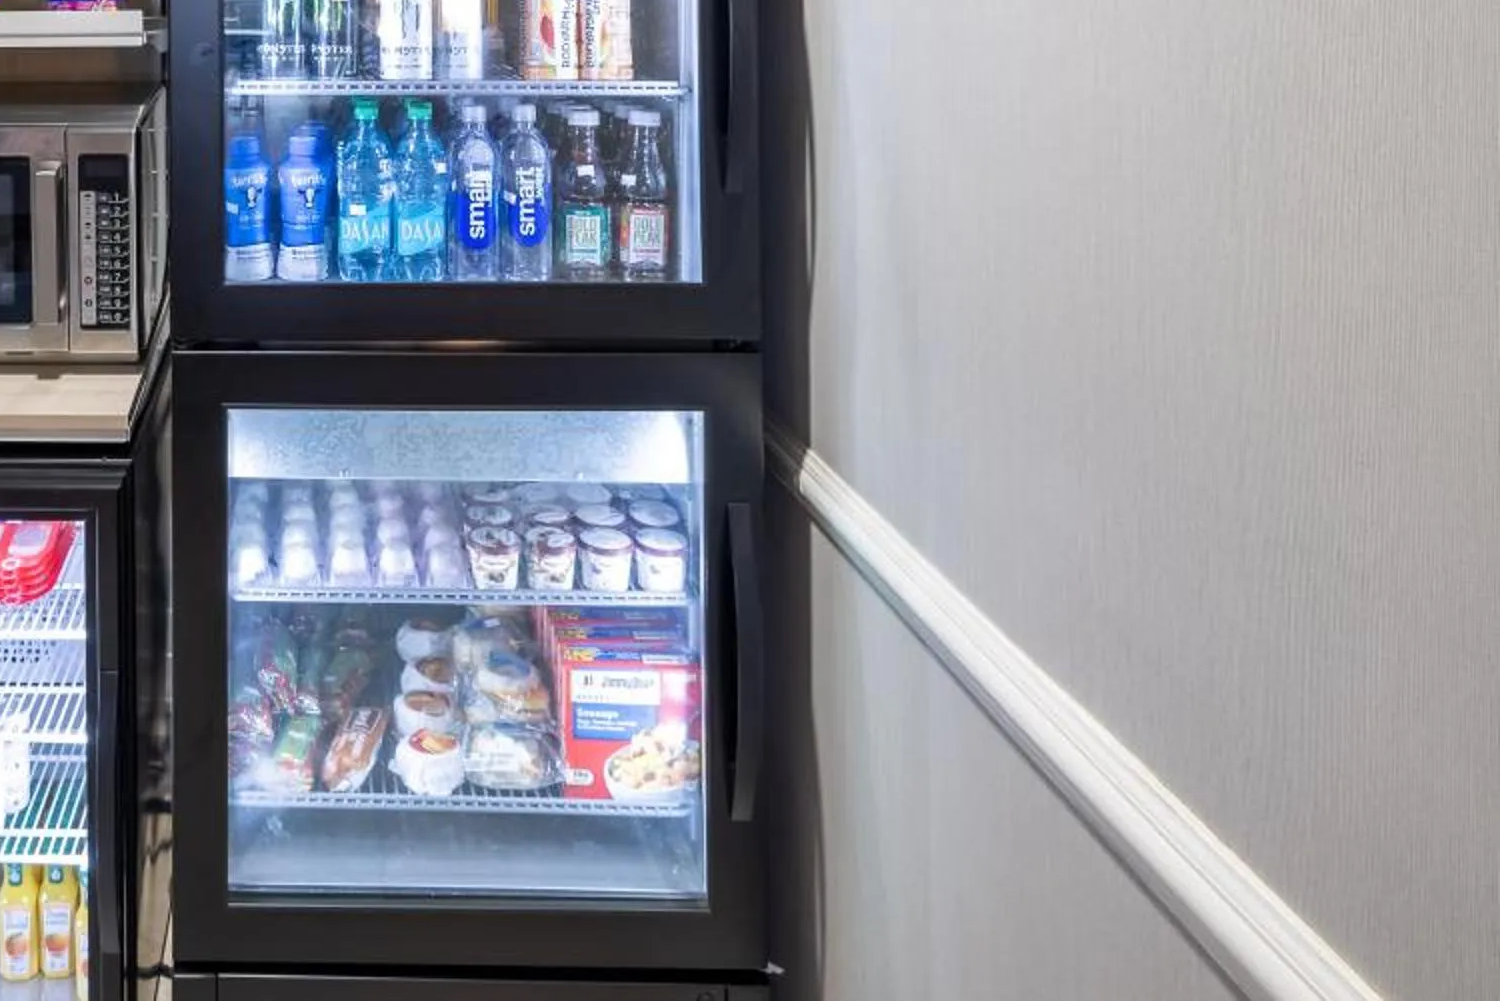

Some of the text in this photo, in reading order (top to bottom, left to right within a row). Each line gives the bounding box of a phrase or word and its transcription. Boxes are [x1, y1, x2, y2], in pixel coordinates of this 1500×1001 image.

[467, 168, 487, 240] smart
[516, 165, 536, 237] smart
[341, 217, 390, 245] DASAN
[401, 218, 445, 244] DASA
